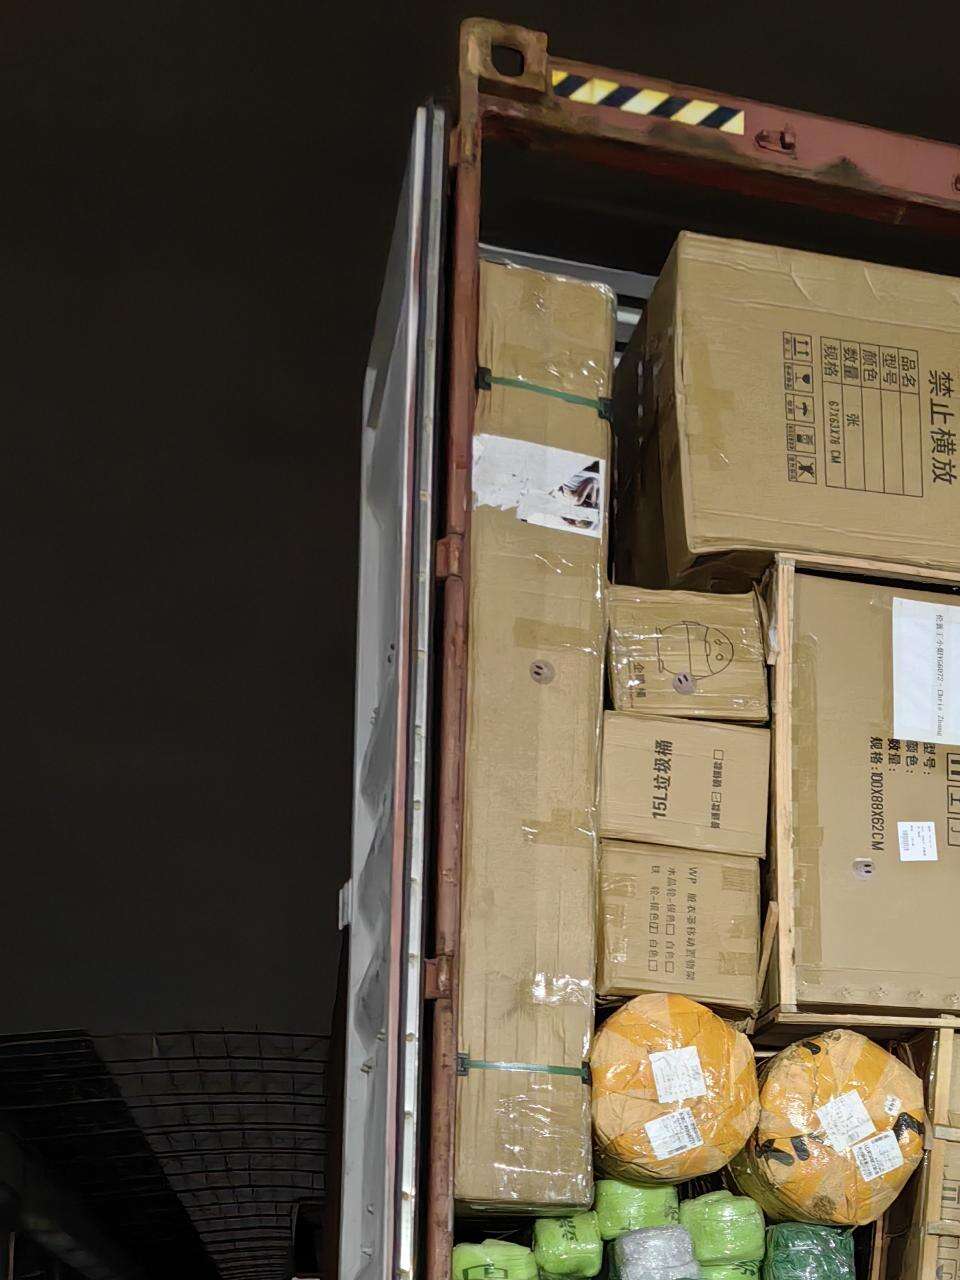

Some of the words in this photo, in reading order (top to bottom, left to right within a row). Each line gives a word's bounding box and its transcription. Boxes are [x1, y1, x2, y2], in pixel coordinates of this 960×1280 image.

[823, 343, 839, 377] 规格
[842, 346, 860, 380] 数量
[862, 349, 879, 383] 颜色
[881, 352, 898, 386] 型号
[900, 355, 917, 388] 品名
[846, 412, 860, 427] 张
[927, 369, 958, 486] 禁止横放
[830, 449, 842, 464] CM
[651, 738, 674, 820] 15L垃圾桶
